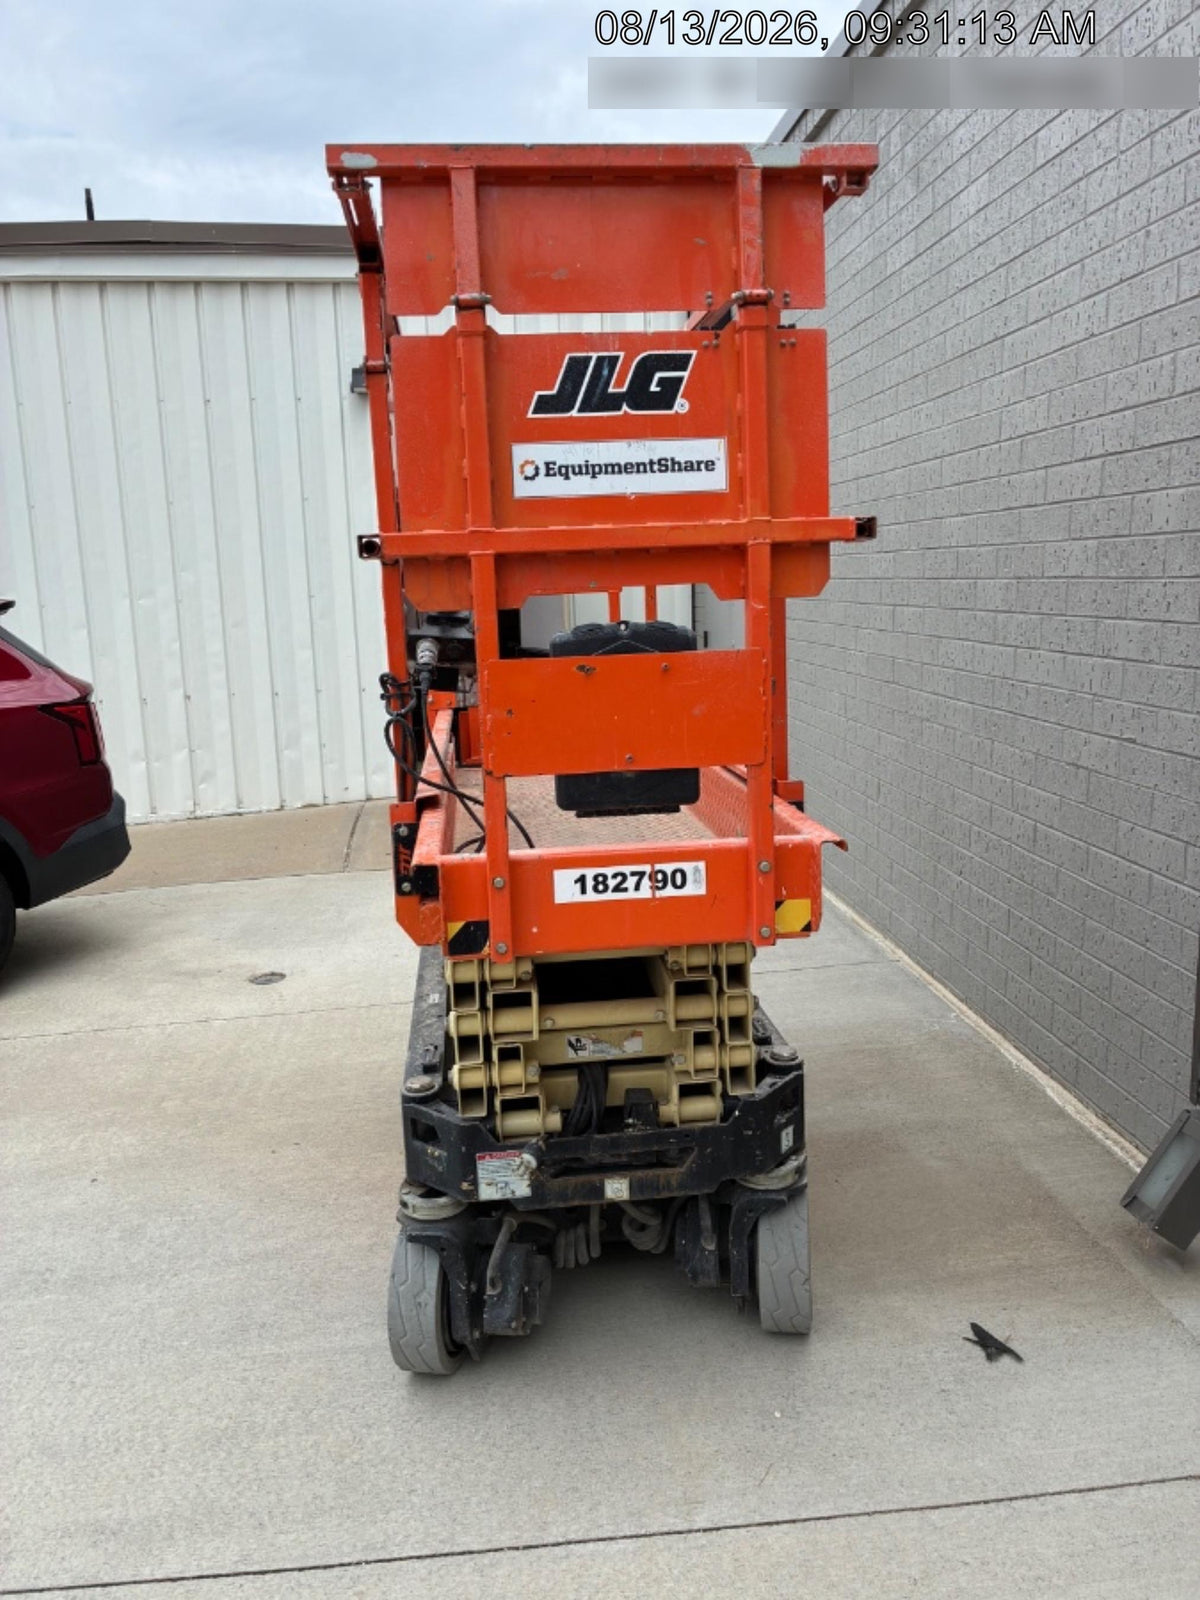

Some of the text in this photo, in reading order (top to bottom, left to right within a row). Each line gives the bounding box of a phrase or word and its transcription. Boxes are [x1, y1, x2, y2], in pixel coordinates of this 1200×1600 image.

[528, 351, 696, 417] JLG
[544, 457, 716, 481] EquipmentShare
[574, 868, 687, 895] 182790
